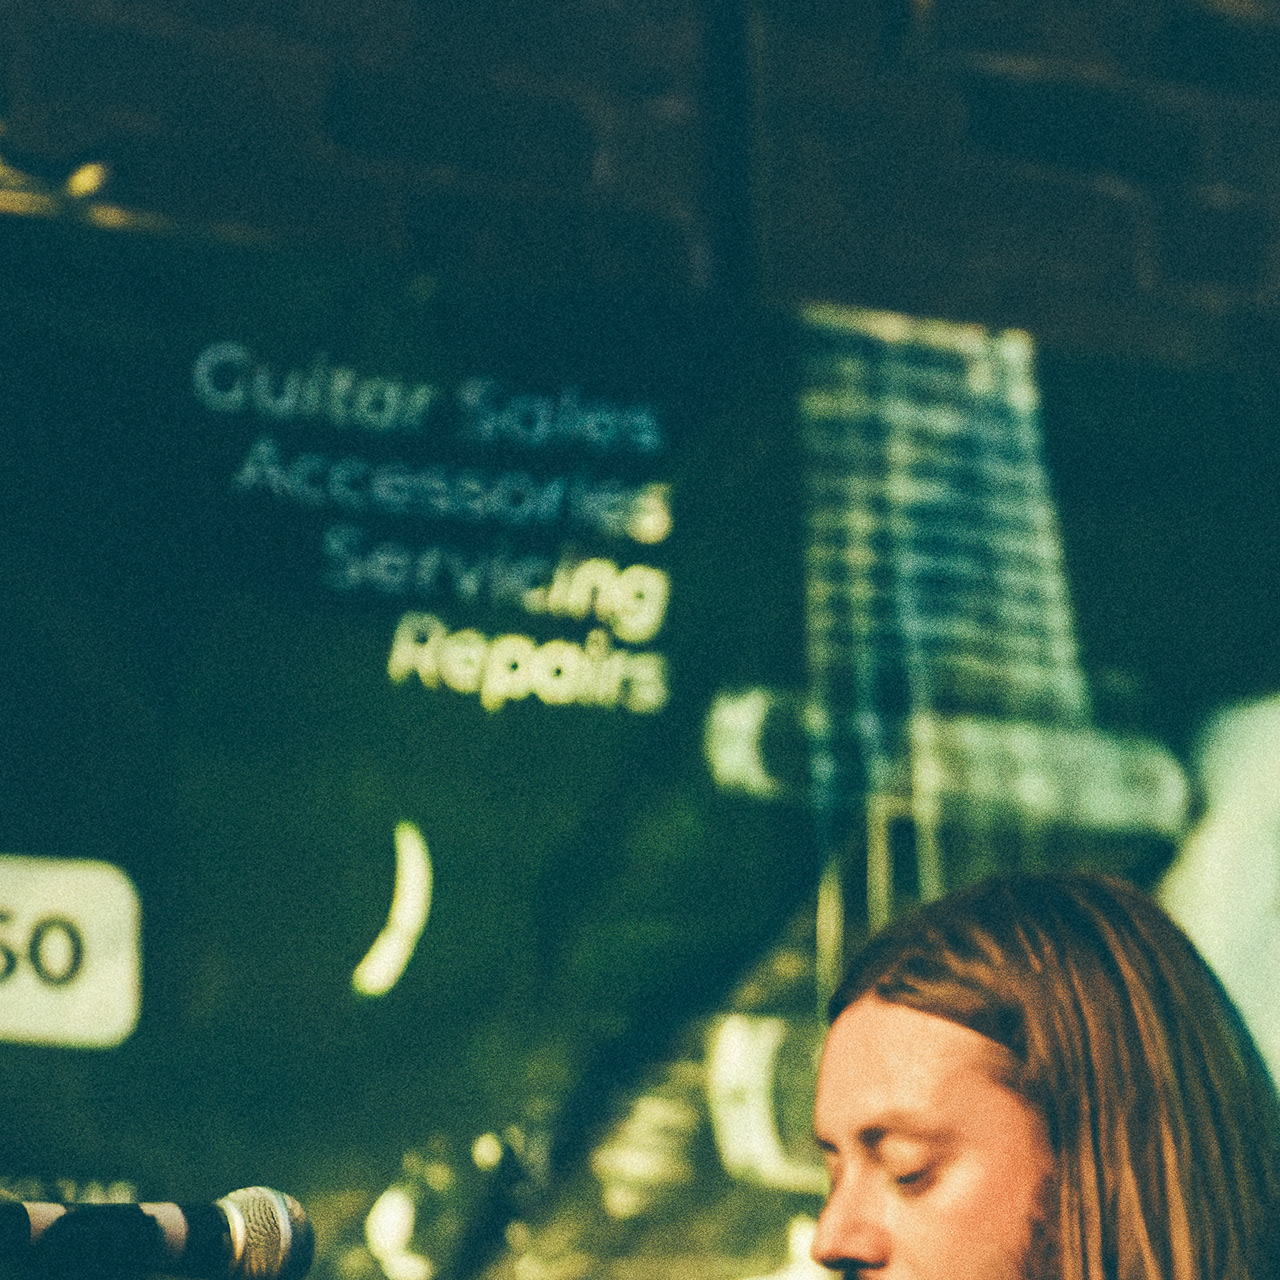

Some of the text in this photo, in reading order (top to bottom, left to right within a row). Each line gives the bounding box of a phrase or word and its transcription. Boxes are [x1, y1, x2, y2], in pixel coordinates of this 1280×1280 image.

[193, 341, 662, 451] Guitar Sales
[232, 436, 672, 543] Accessories
[322, 523, 669, 642] Servicing
[387, 612, 668, 712] Repairs
